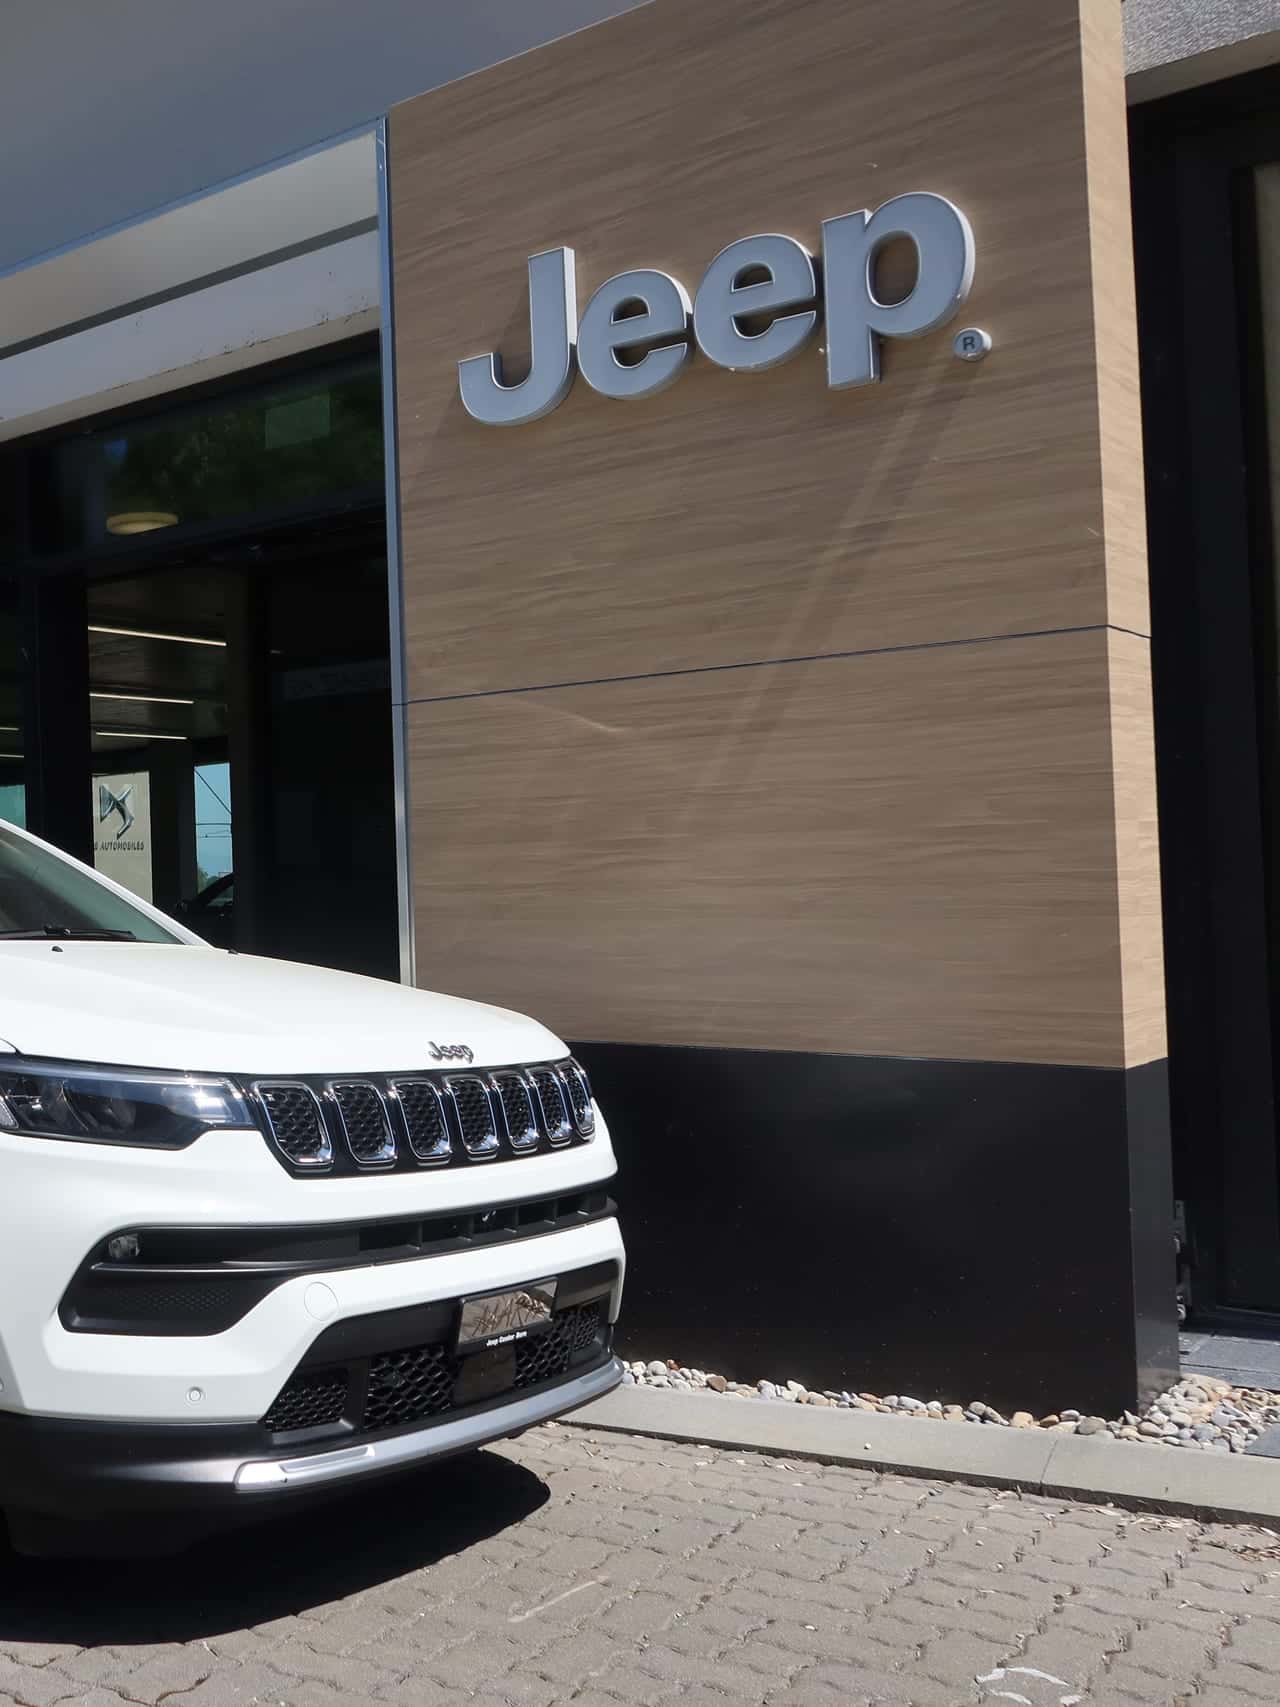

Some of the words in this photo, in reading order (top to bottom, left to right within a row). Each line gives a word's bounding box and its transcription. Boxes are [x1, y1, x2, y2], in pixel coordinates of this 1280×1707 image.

[457, 191, 976, 426] Jeep
[100, 840, 145, 851] AUTOMOBILES
[428, 1041, 474, 1064] Jeep
